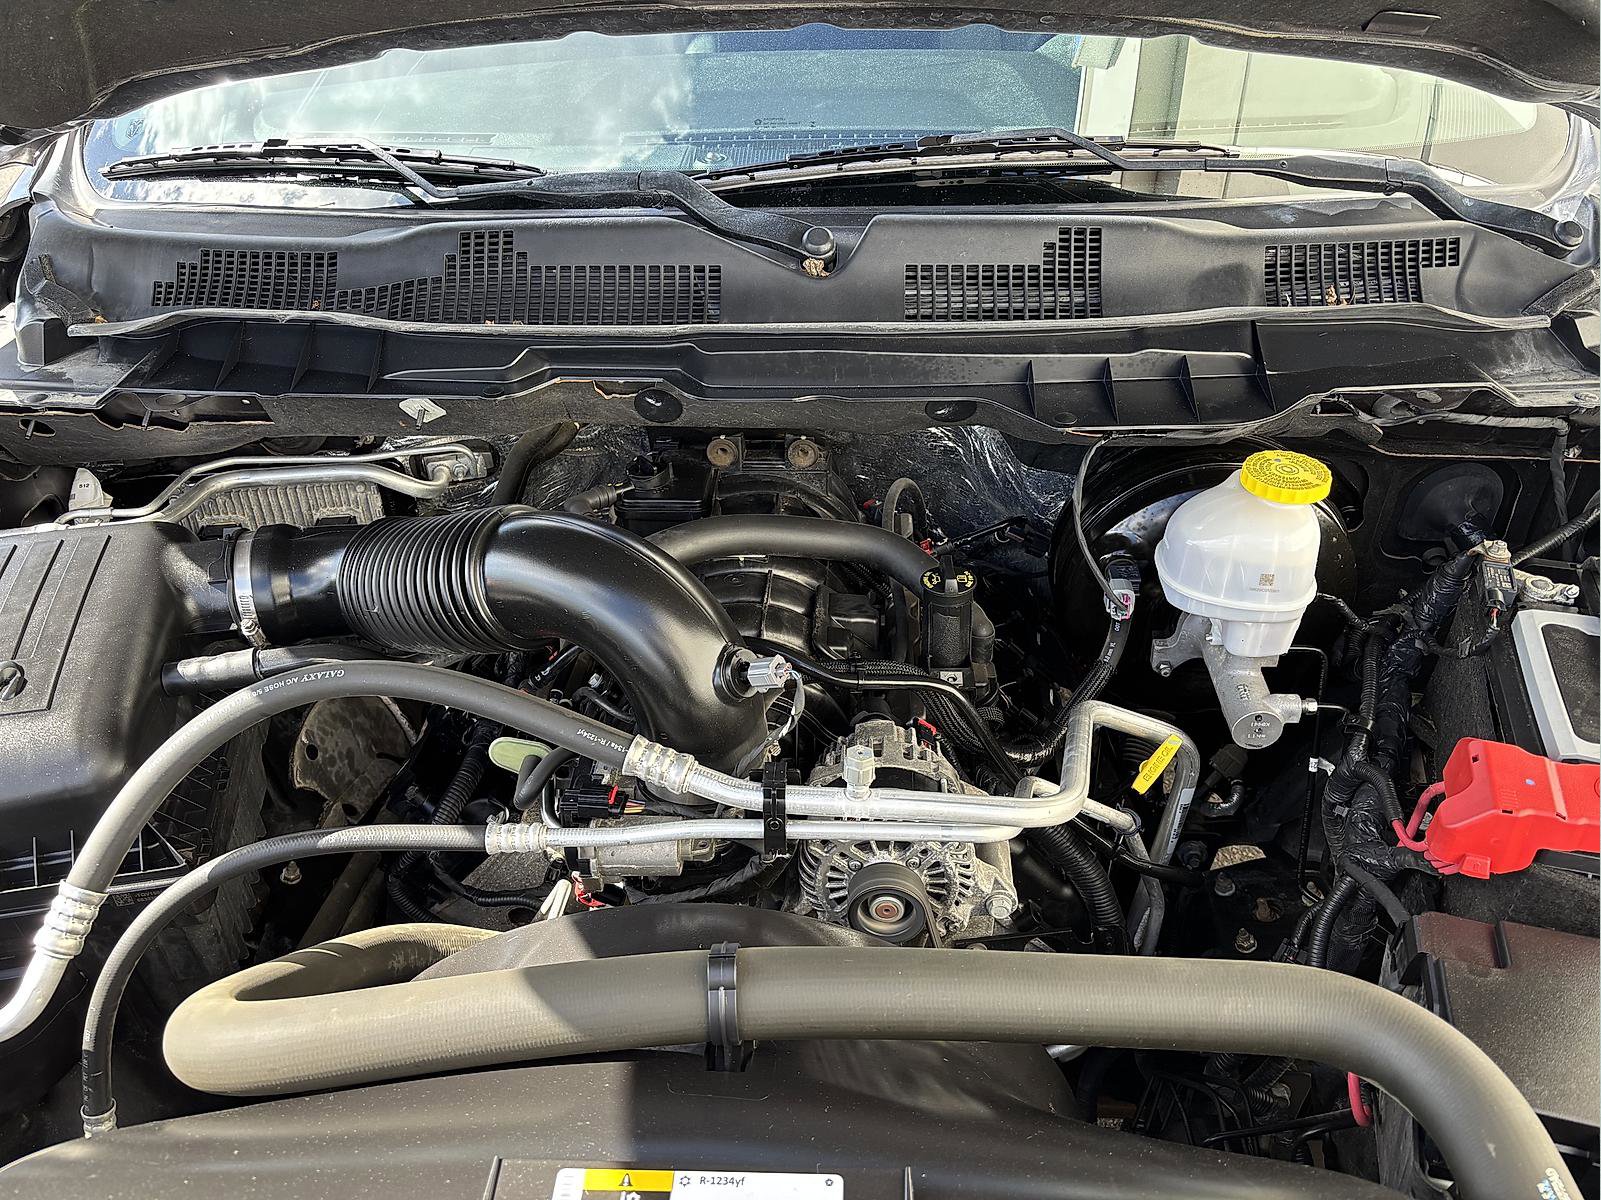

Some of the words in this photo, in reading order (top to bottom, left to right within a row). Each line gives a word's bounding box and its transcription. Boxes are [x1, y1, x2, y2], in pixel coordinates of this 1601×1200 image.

[285, 676, 299, 687] A/C
[300, 668, 345, 683] GALAXY
[263, 680, 285, 693] HOSE
[576, 729, 606, 746] R-1234yf
[1142, 754, 1166, 783] ENGINE
[1160, 745, 1174, 757] OIL
[698, 1175, 745, 1187] R-1234yf
